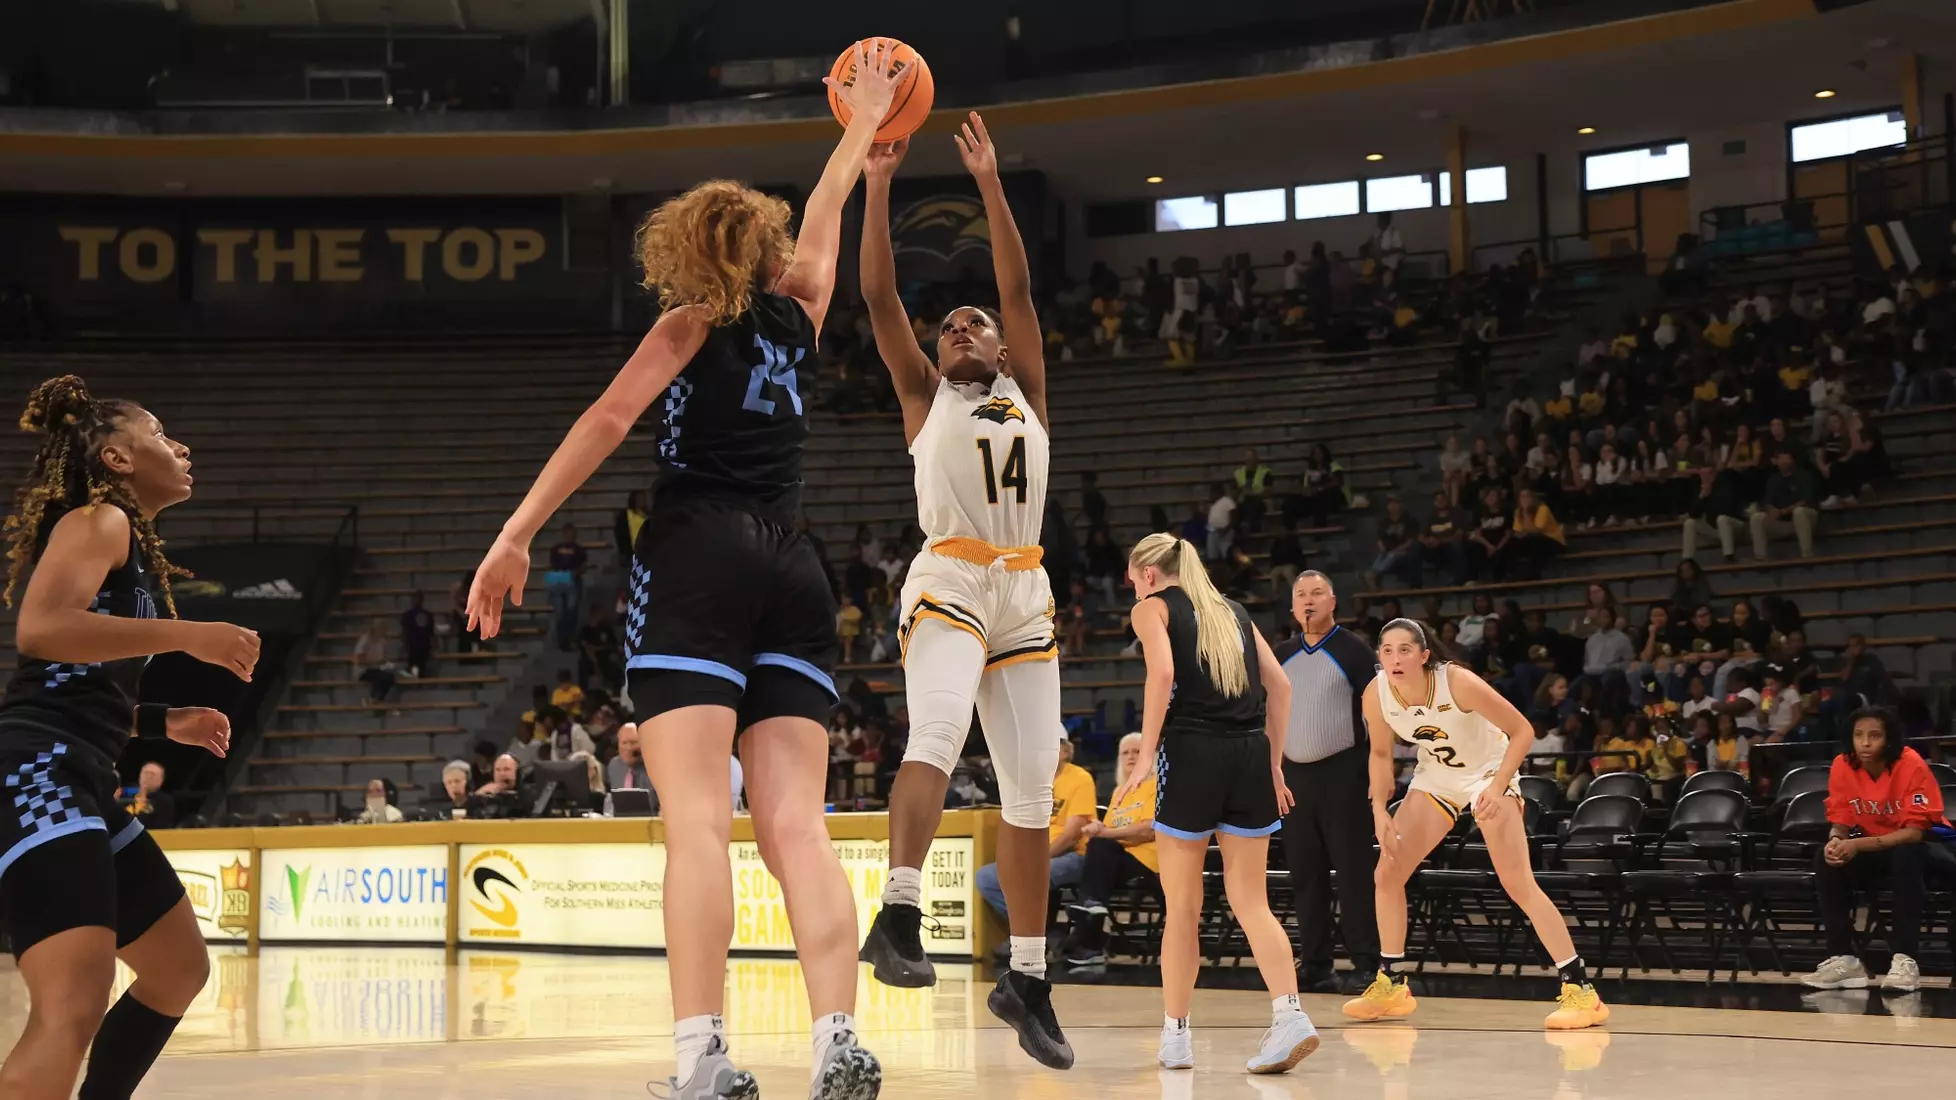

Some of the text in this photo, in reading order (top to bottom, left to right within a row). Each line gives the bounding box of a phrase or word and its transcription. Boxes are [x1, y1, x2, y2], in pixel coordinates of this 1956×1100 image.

[58, 227, 546, 282] TO THE TOP
[742, 333, 805, 416] 24
[976, 434, 1027, 505] 14
[932, 850, 965, 868] GET IT
[932, 871, 965, 888] TODAY
[313, 867, 448, 904] AIRSOUTH
